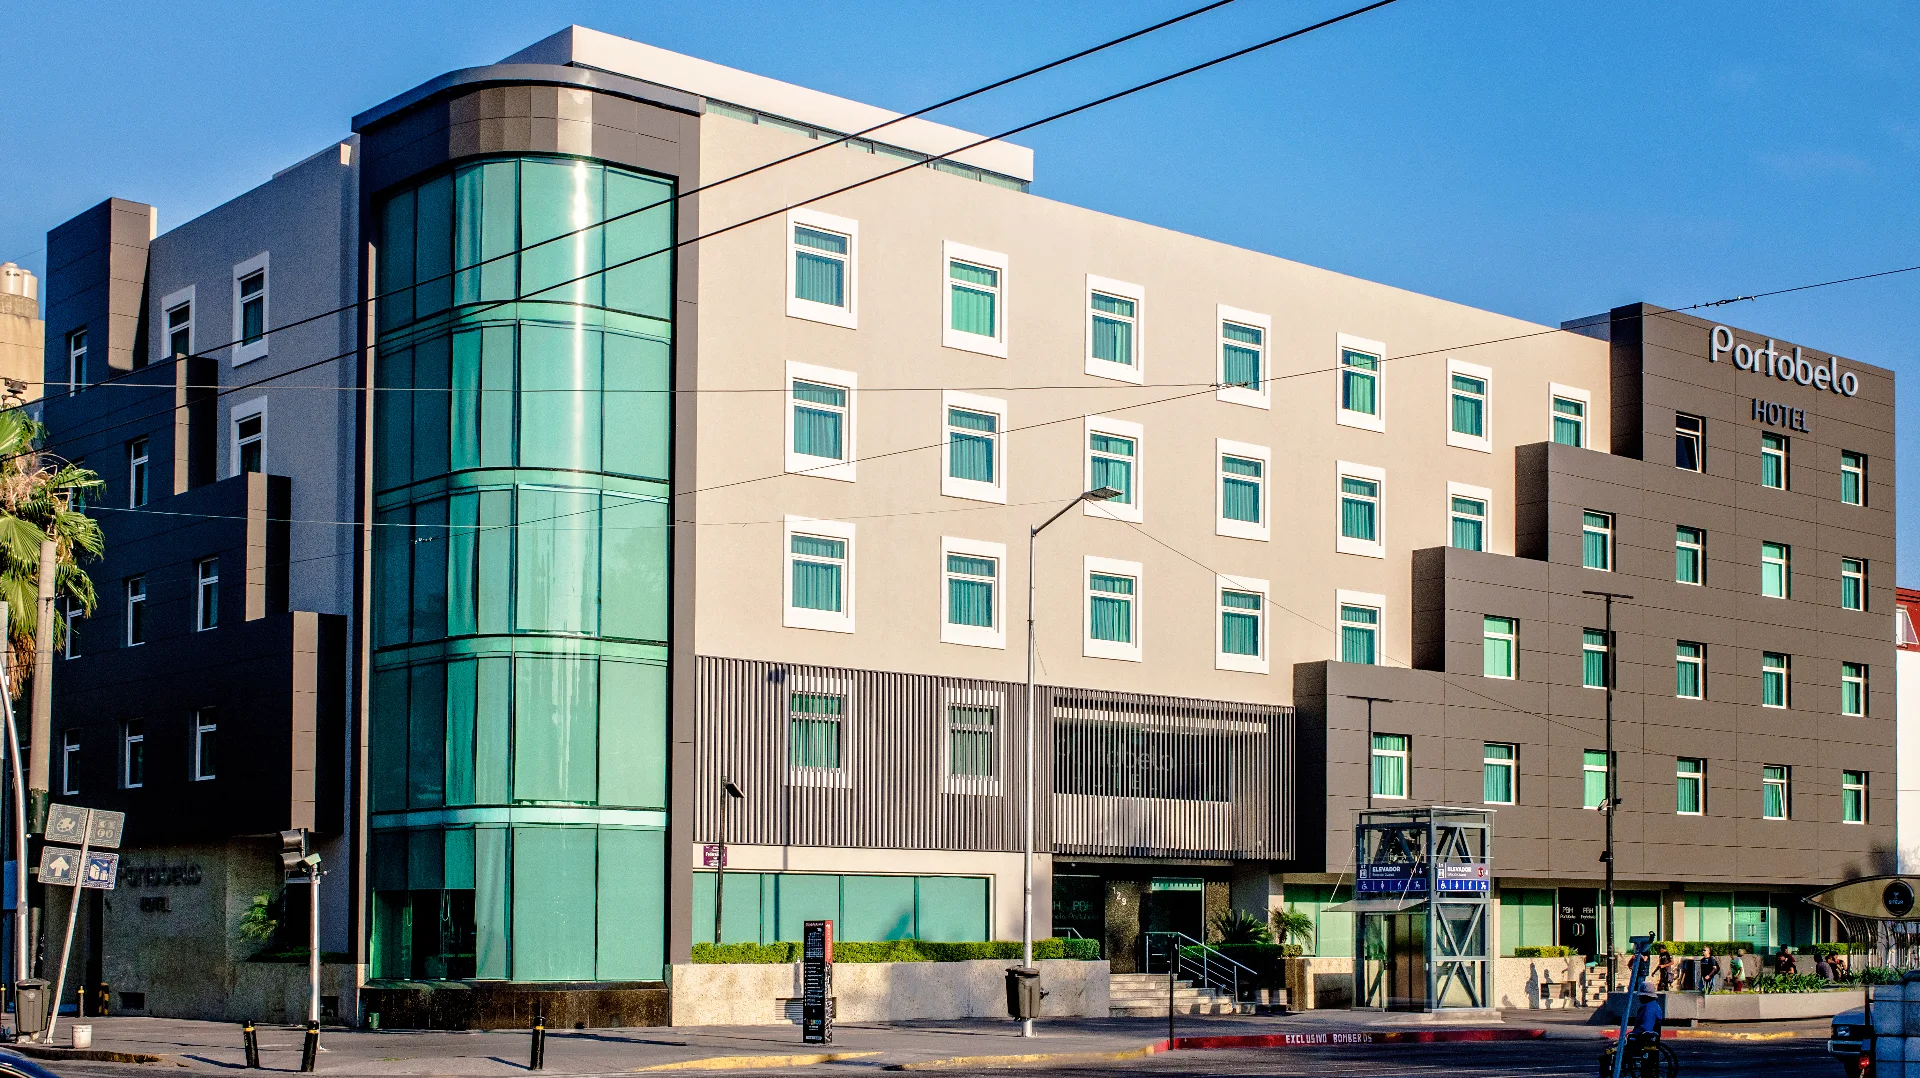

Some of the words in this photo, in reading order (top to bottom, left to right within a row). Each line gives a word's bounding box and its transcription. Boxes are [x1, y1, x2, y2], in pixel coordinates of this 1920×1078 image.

[1709, 325, 1859, 397] Portobelo
[1752, 397, 1811, 433] HOTEL
[1285, 1034, 1327, 1044] EXCLUSIVO
[1332, 1033, 1372, 1043] BOMBEROS
